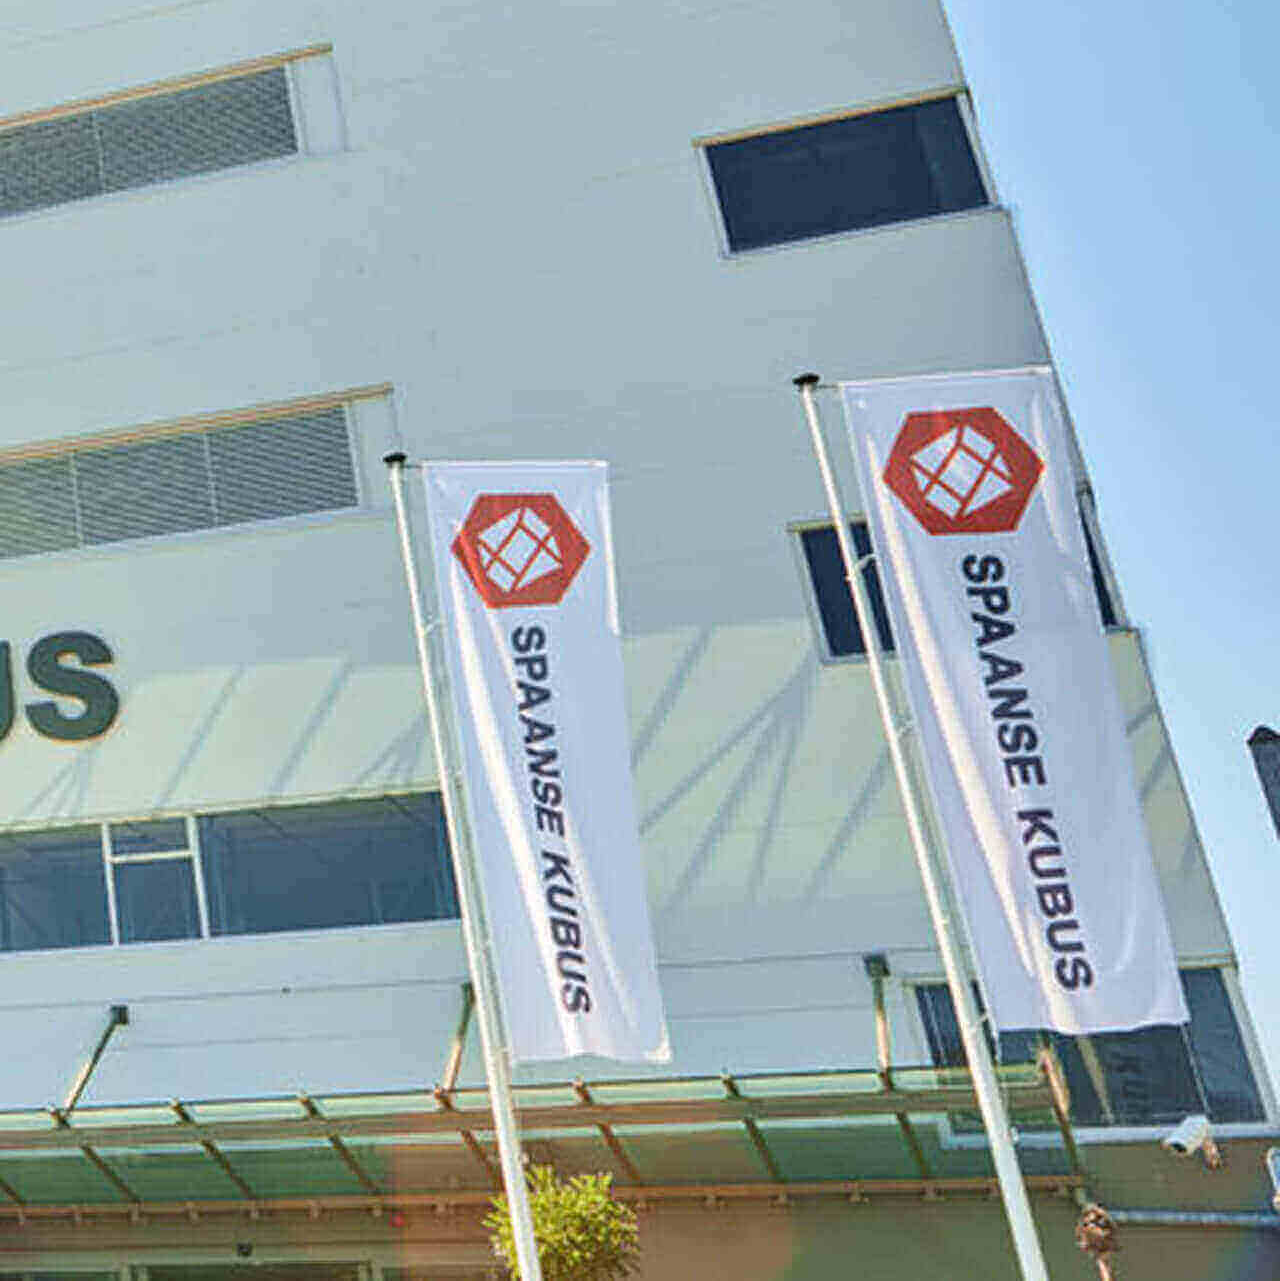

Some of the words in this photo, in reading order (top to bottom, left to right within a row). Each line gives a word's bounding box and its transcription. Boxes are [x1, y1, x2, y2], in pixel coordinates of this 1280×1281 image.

[511, 625, 565, 837] SPAANSE
[541, 850, 591, 1015] KUBUS
[960, 553, 1047, 788] SPAANSE
[1016, 808, 1094, 992] KUBUS
